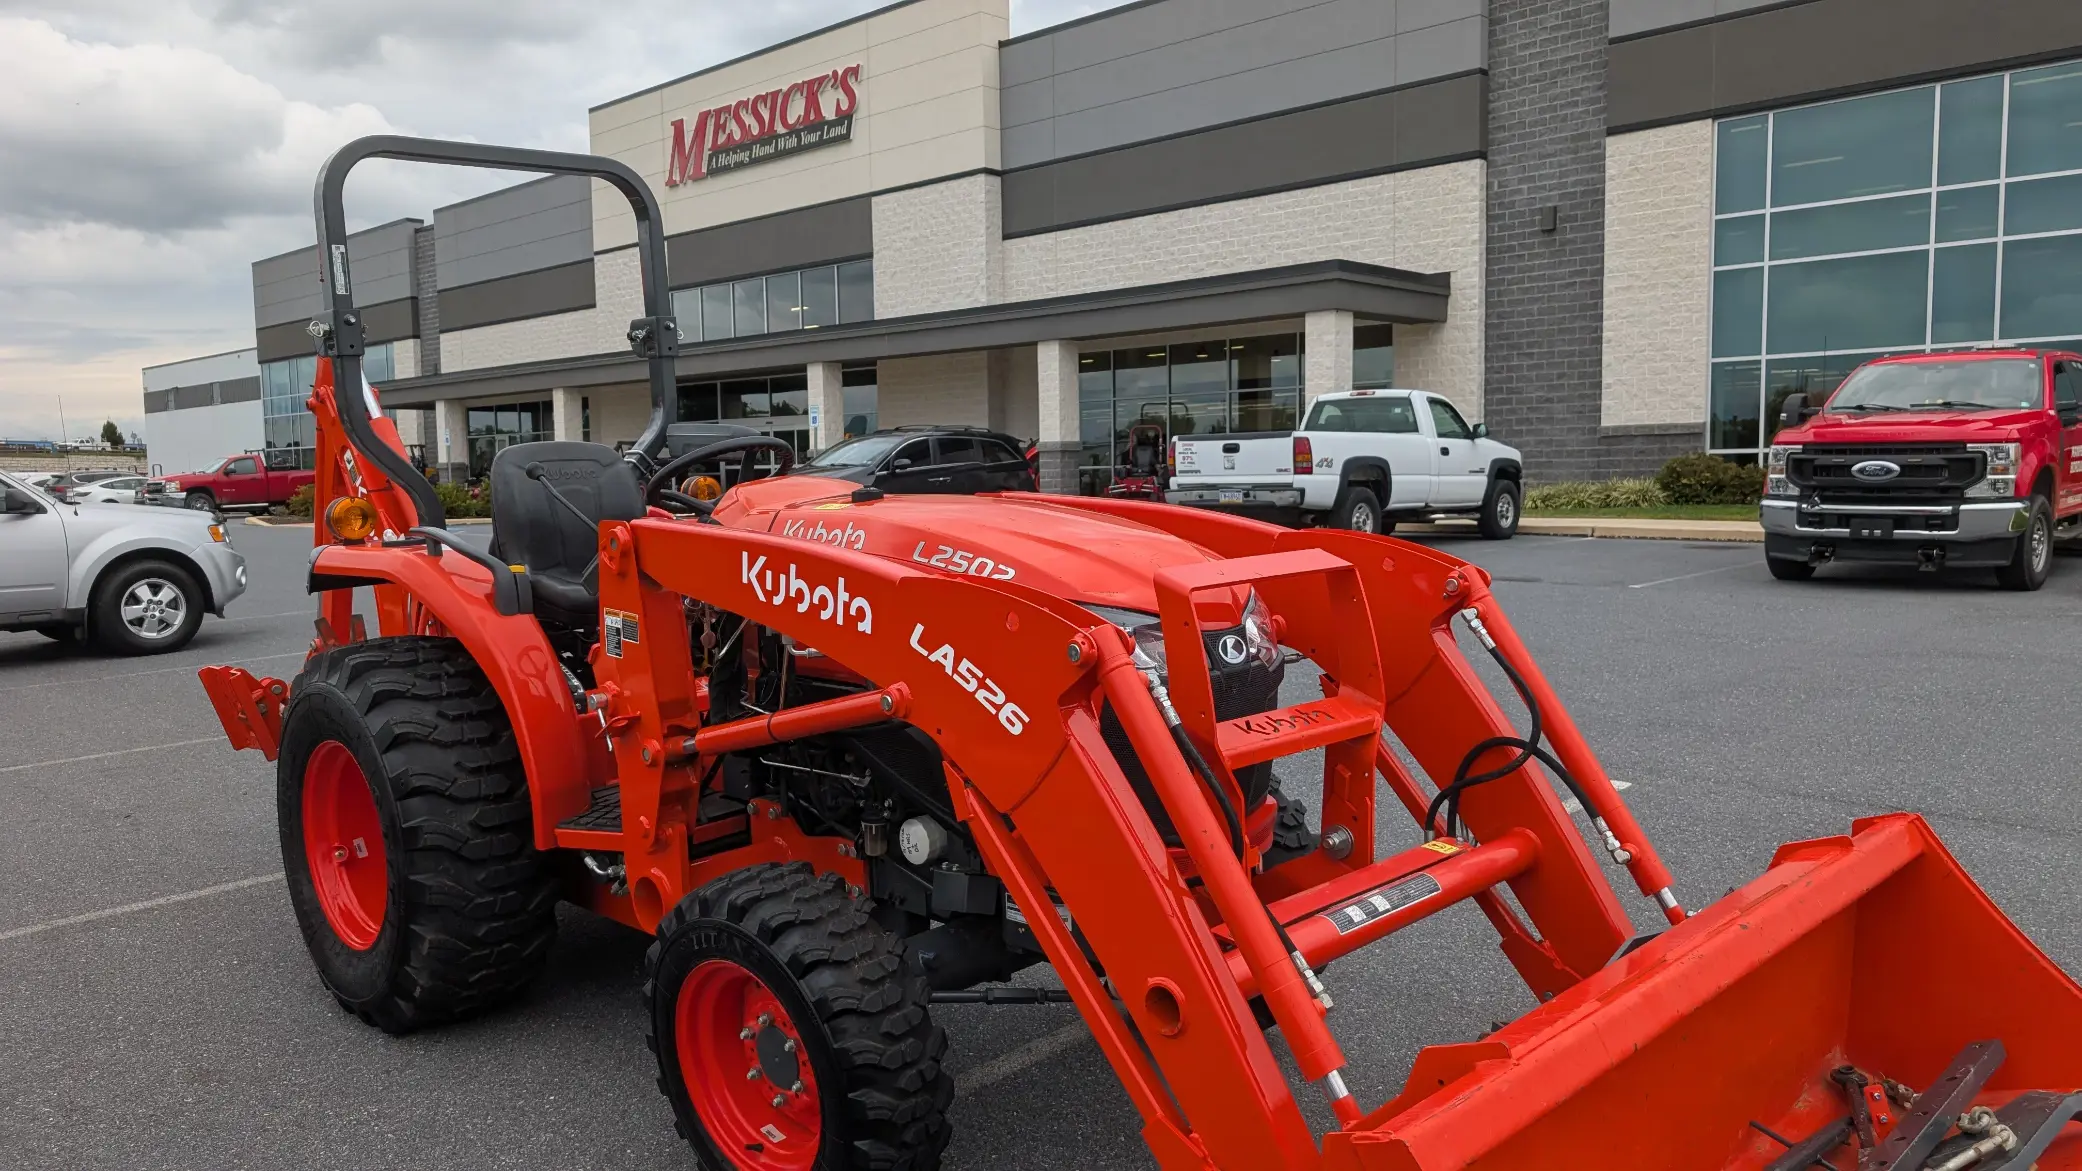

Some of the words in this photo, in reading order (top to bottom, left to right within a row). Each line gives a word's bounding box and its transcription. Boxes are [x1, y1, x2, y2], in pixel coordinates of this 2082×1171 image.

[665, 64, 861, 187] MESSICK'S
[709, 158, 717, 169] A
[718, 149, 750, 168] Helping
[752, 140, 775, 159] Hand
[777, 134, 798, 150] With
[800, 128, 822, 144] Your
[823, 120, 847, 139] Land
[742, 551, 872, 634] Kubota
[909, 623, 1031, 736] LA526
[1232, 708, 1336, 736] Kubota
